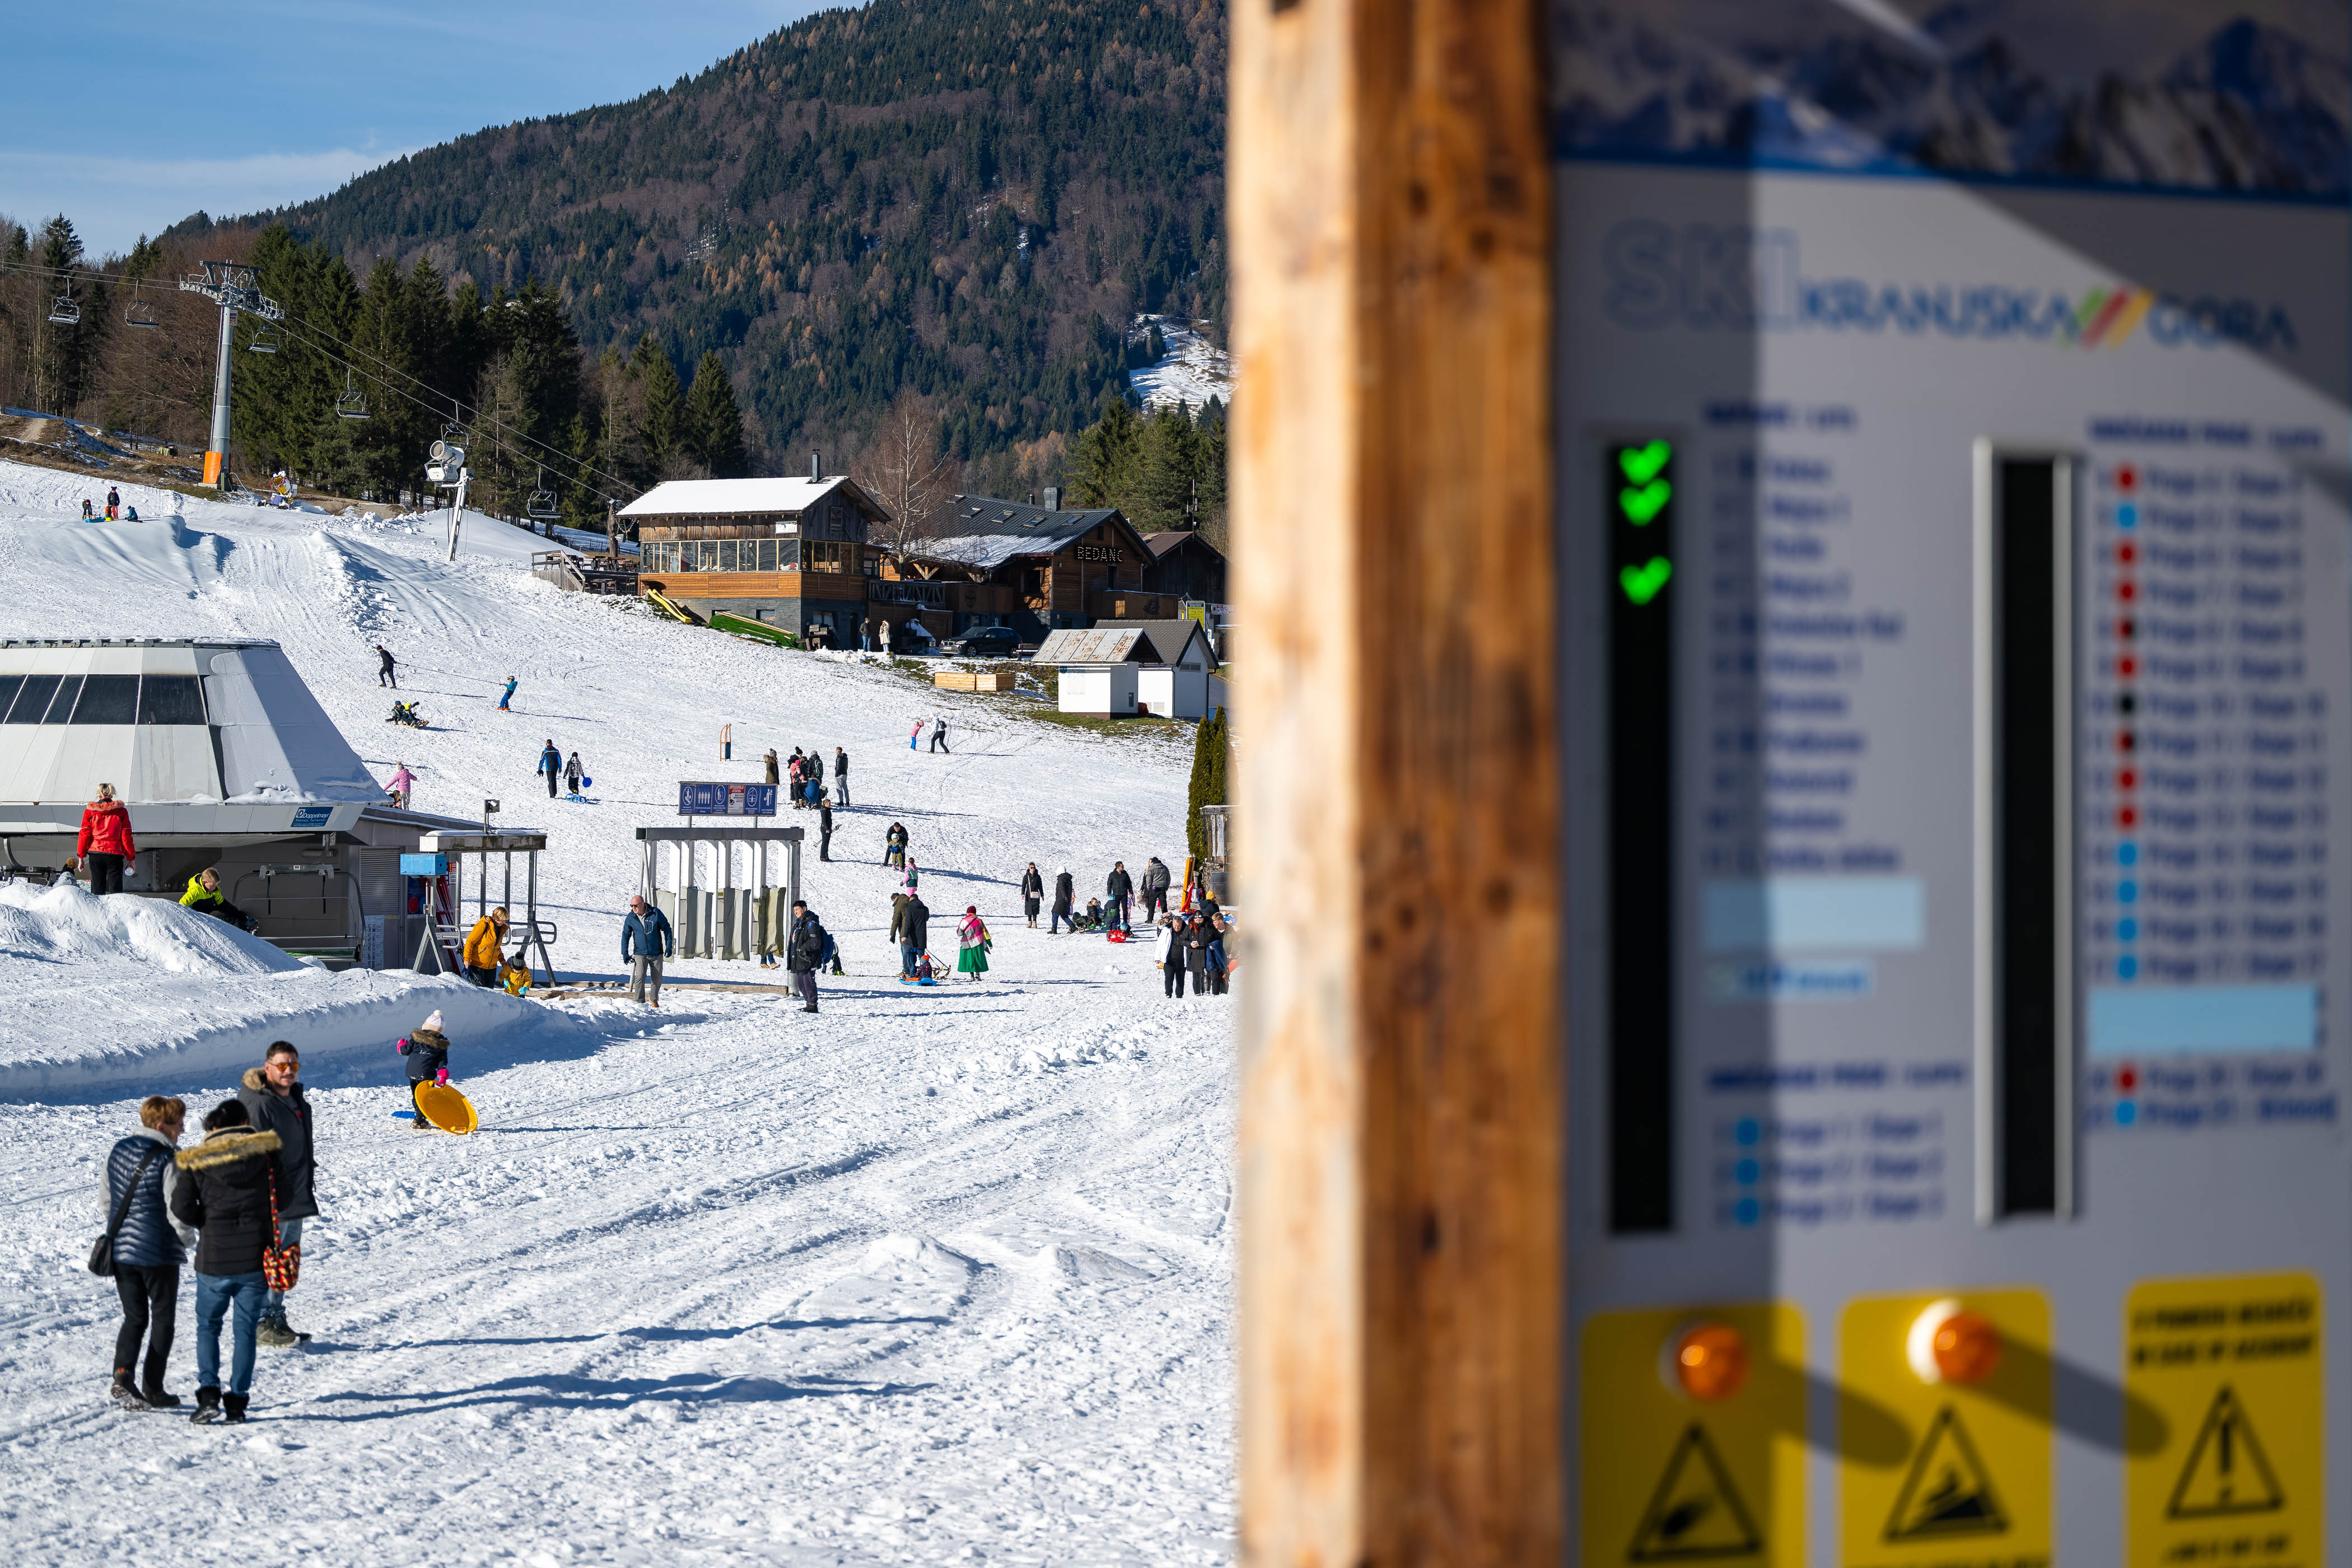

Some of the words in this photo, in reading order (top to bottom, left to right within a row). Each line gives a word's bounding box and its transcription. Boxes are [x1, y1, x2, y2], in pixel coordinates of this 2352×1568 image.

[1602, 217, 1801, 334] SKI
[2146, 293, 2299, 349] GORA
[1077, 546, 1123, 562] BEDANC
